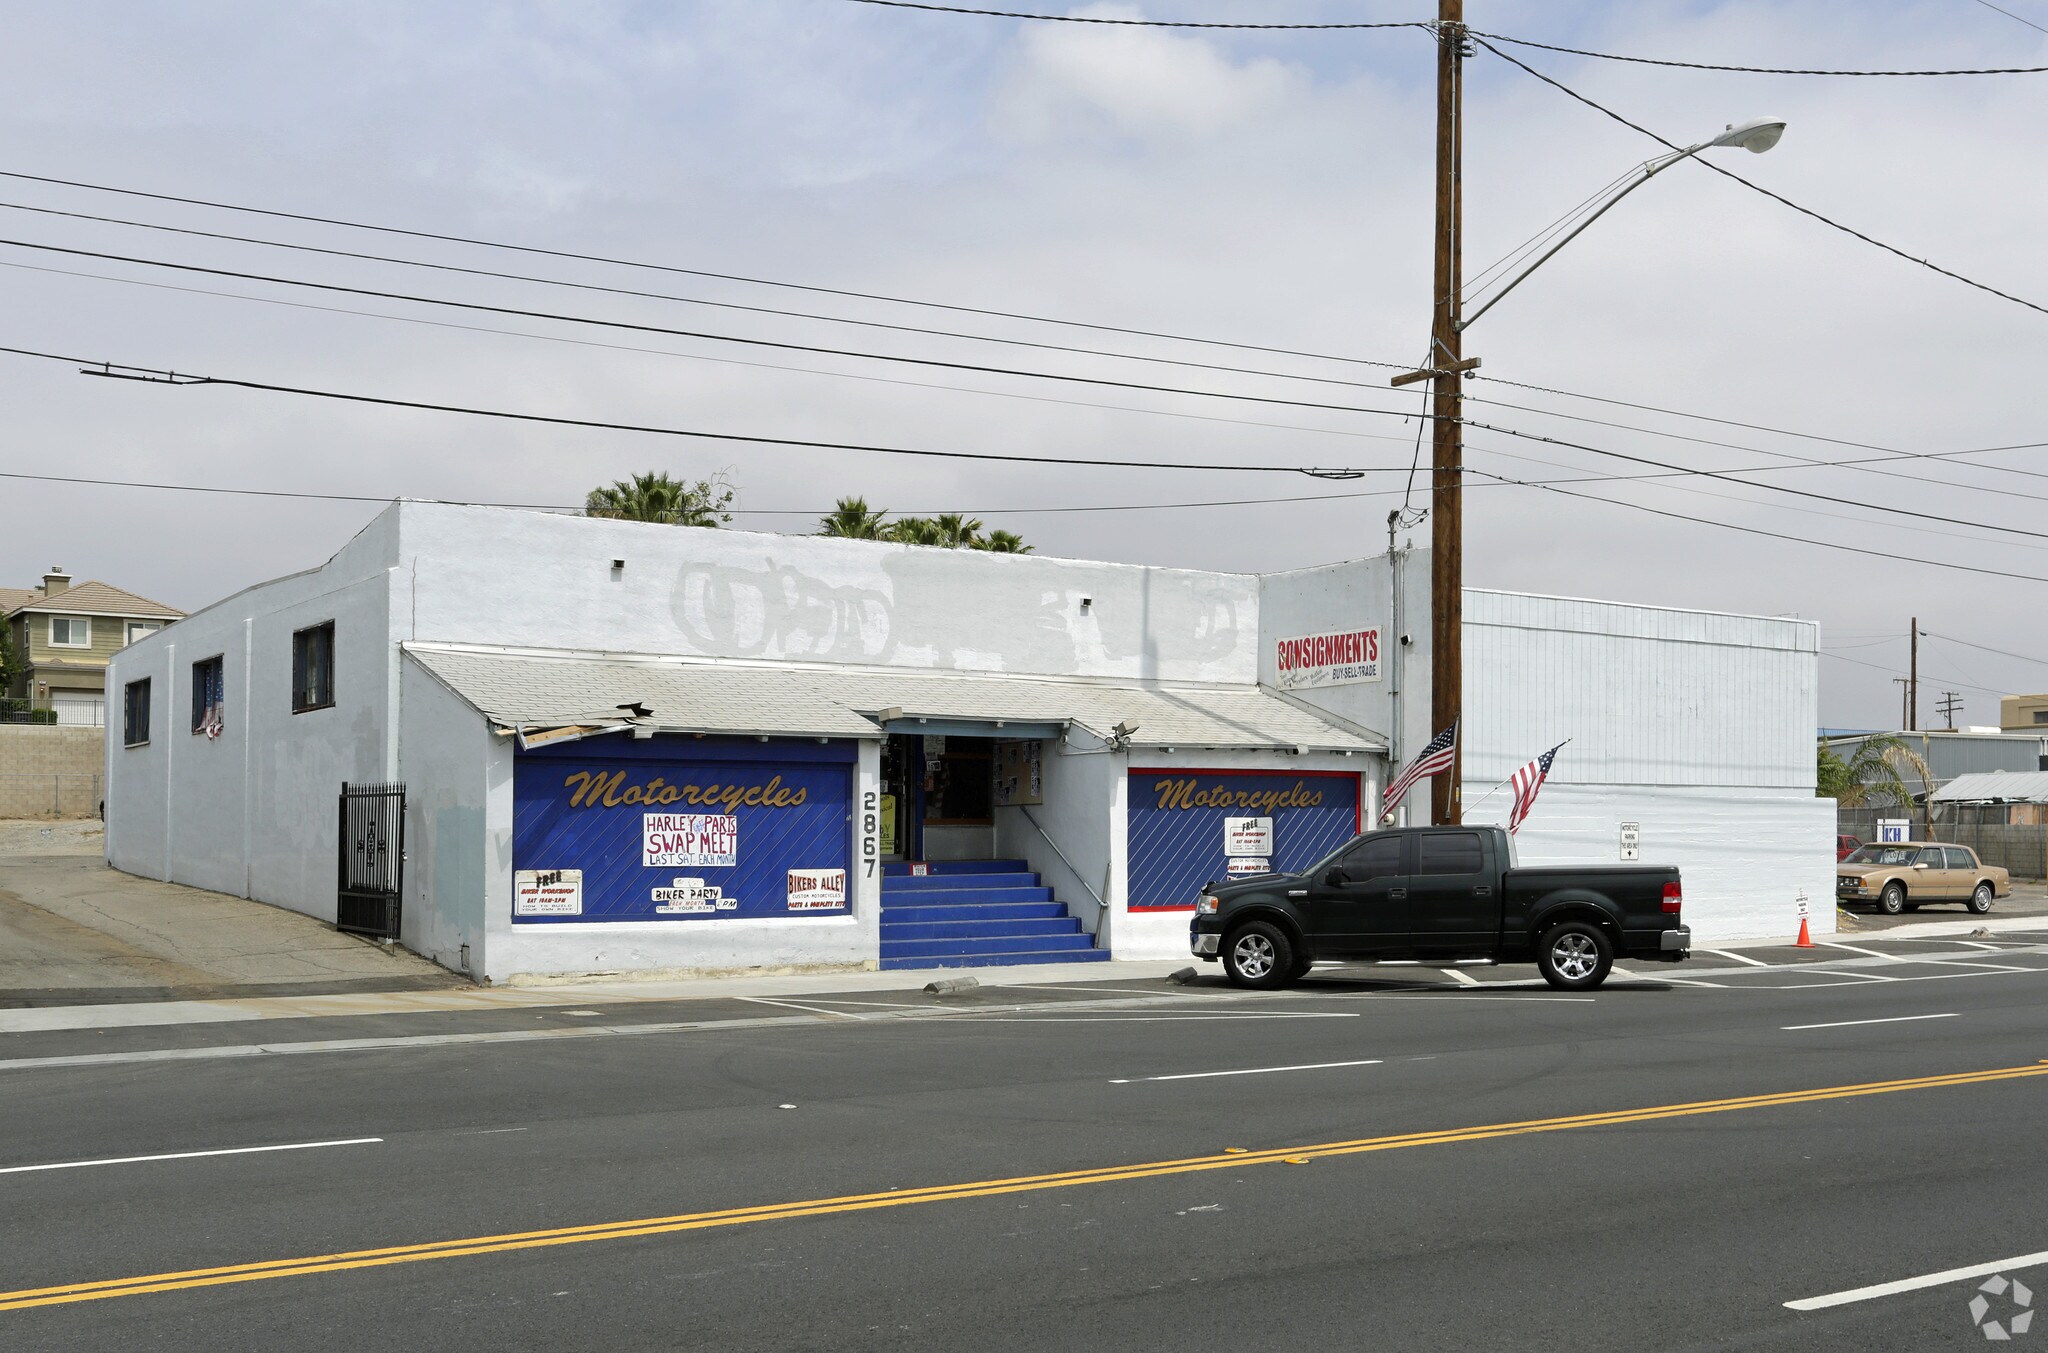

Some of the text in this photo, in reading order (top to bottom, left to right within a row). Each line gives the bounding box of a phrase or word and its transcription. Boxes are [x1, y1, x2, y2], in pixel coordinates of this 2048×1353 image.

[1278, 630, 1377, 670] CONSIGNMENTS
[564, 770, 807, 815] Motorcycles
[1154, 779, 1322, 815] Motorcycles
[647, 816, 735, 832] HARLEY PARTS
[1242, 819, 1258, 831] FREE
[646, 832, 736, 854] SWAP MEET
[650, 853, 674, 865] LAST
[699, 853, 714, 865] EACH
[536, 870, 562, 888] FREE
[789, 873, 844, 894] BIKERS ALLEY
[656, 889, 718, 900] BIKER PARTY
